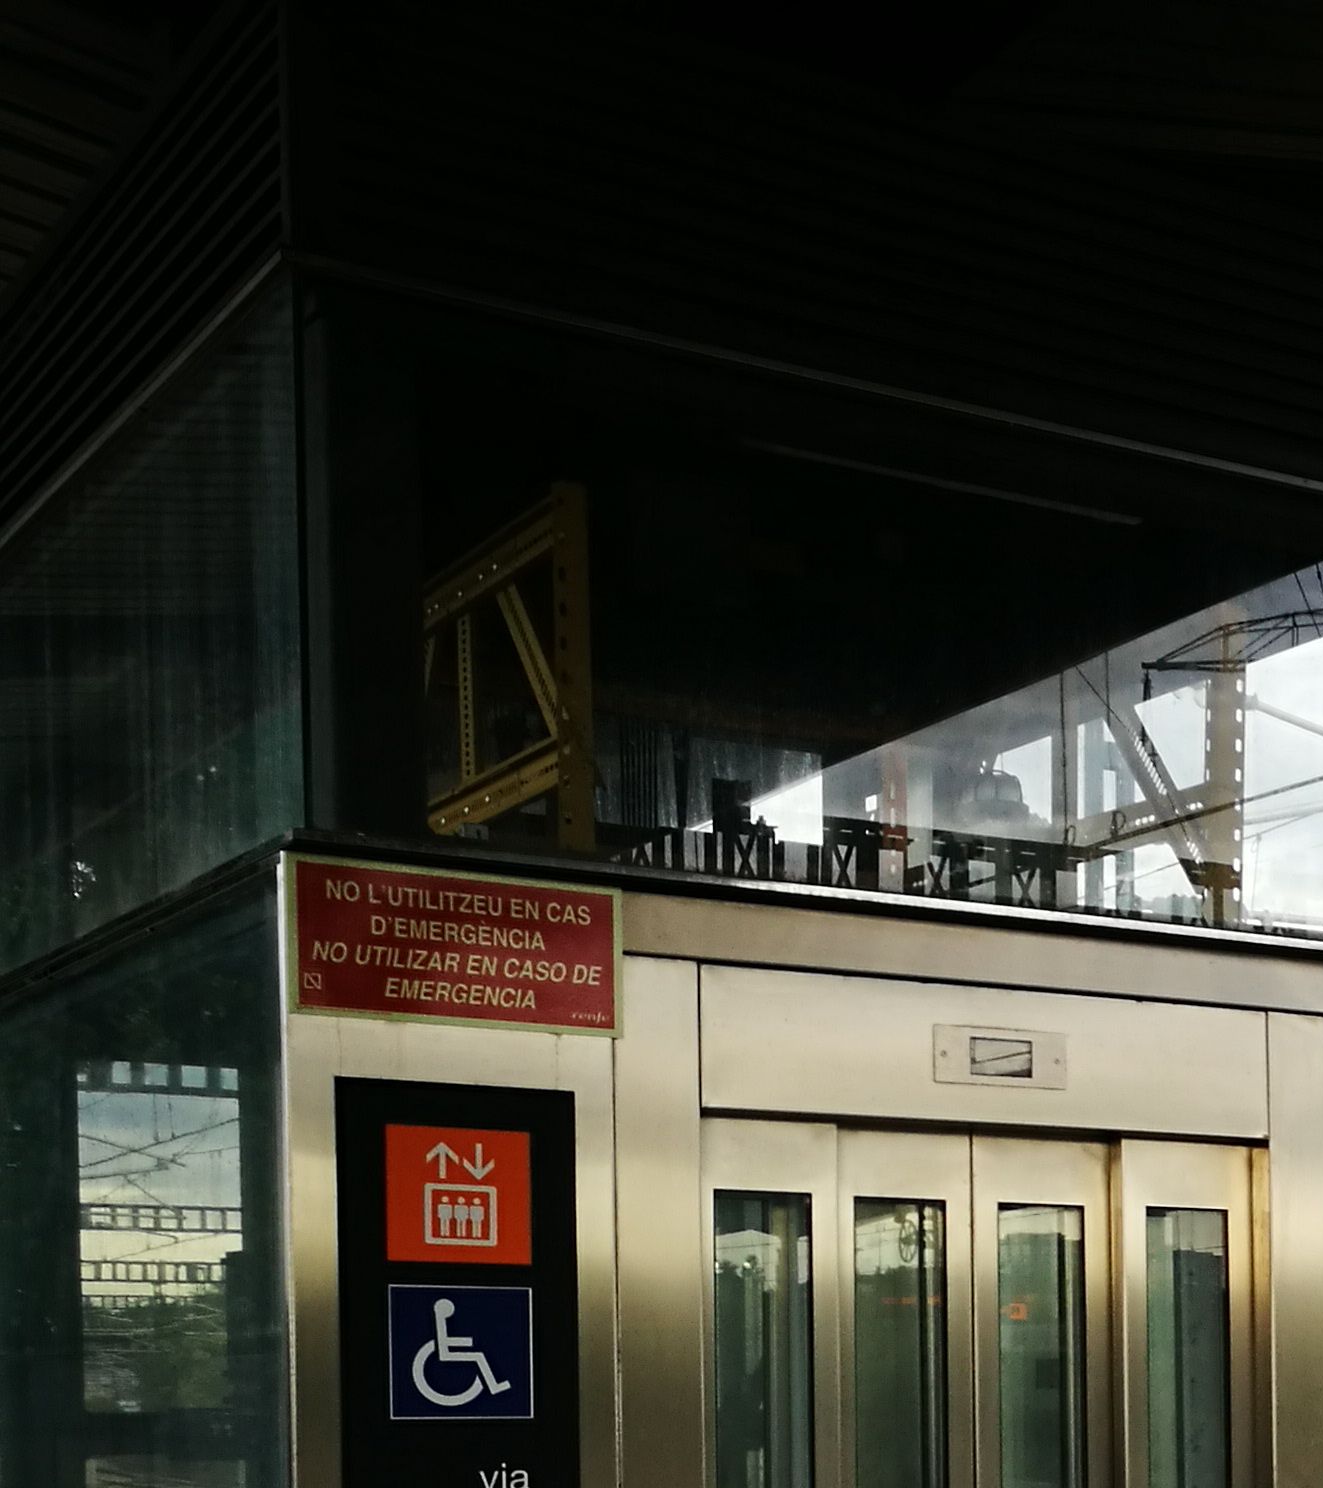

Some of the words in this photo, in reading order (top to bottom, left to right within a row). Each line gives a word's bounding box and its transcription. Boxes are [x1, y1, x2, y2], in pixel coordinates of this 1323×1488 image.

[325, 879, 360, 902] NO
[368, 883, 502, 917] L'UTILITZEU
[510, 898, 540, 920] EN
[546, 902, 592, 926] CAS
[371, 914, 546, 951] D'EMERGÈNCIA
[312, 940, 348, 963] NO
[355, 944, 461, 974] UTILIZAR
[466, 954, 498, 976] EN
[504, 958, 567, 983] CASO
[573, 964, 603, 985] DE
[384, 977, 537, 1009] EMERGENCIA
